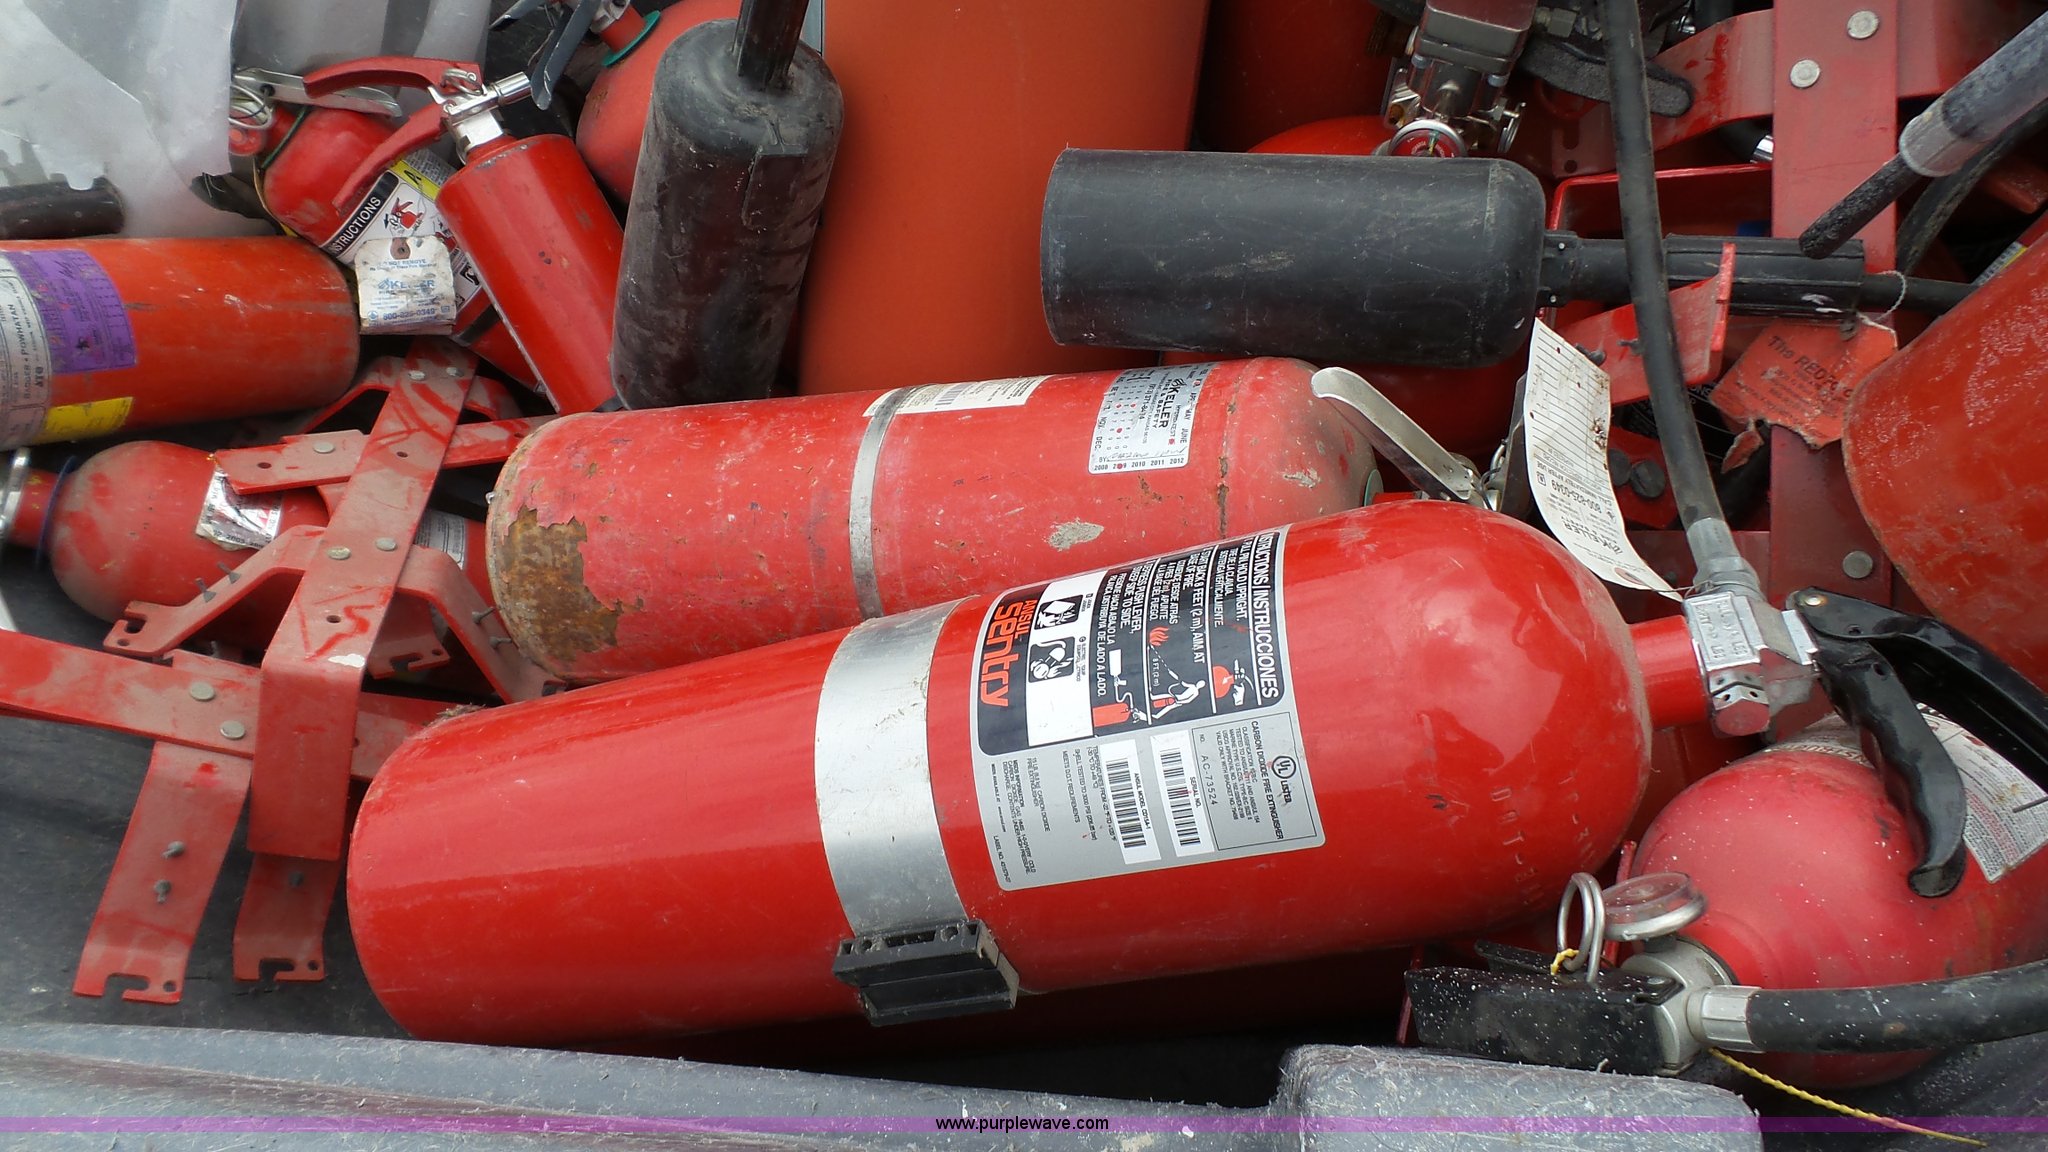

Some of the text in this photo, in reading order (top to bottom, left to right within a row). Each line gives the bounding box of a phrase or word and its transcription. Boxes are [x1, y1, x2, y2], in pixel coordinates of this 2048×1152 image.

[7, 303, 28, 355] POWHATAN
[1152, 399, 1163, 427] SAFETY
[1158, 386, 1180, 428] KELLER
[1196, 551, 1208, 565] START
[1154, 573, 1163, 585] BASE
[1181, 552, 1196, 590] BASE OF FIRE.
[1194, 565, 1205, 582] BACK
[1236, 564, 1245, 582] HOLD
[1124, 582, 1136, 597] SIDE
[1133, 587, 1145, 603] PUSH
[1152, 586, 1160, 596] DEL
[1192, 587, 1201, 606] FEET
[1108, 594, 1120, 610] HACIA
[1122, 597, 1132, 607] TO
[1149, 597, 1159, 620] FUEGO.
[1159, 594, 1167, 619] APUNTE
[1169, 582, 1179, 623] DESDE ATRÁS
[1214, 574, 1223, 627] VERTICALMENTE.
[1235, 582, 1247, 621] UPRIGHT.
[1014, 599, 1036, 639] ANSUL
[1098, 595, 1111, 628] DISTRIBUYA
[1107, 611, 1117, 632] ABAJO
[1120, 608, 1131, 628] SIDE.
[1129, 604, 1141, 633] LEVER,
[1190, 608, 1201, 616] (2
[1096, 631, 1105, 640] DE
[1106, 634, 1114, 644] LA
[1192, 632, 1203, 650] AIM
[1096, 642, 1105, 662] LADO
[1193, 651, 1204, 663] AT
[1096, 672, 1105, 696] LADO.
[1228, 728, 1237, 748] MARINE
[1235, 727, 1243, 746] TESTED
[1239, 747, 1245, 755] TO
[1241, 726, 1254, 767] CLASSIFICATION
[1220, 760, 1228, 773] WITH
[1224, 745, 1234, 771] APPROVAL
[1007, 760, 1015, 781] CARBON
[1076, 765, 1085, 785] TESTED
[1133, 772, 1142, 789] ANSUL
[1251, 720, 1283, 839] CARBON DIOXIDE FIRE EXTINGUISHER
[1014, 774, 1025, 807] INFORMATION
[1027, 770, 1039, 806] EXTINGUISHER
[1092, 745, 1103, 787] TEMPERATURES
[1098, 787, 1107, 802] FROM
[1105, 816, 1112, 824] TO
[1189, 776, 1199, 796] SERIAL
[1223, 773, 1233, 797] BRACKET
[1280, 779, 1291, 803] LISTED
[1067, 782, 1080, 823] REQUIREMENTS
[1137, 790, 1146, 808] MODEL
